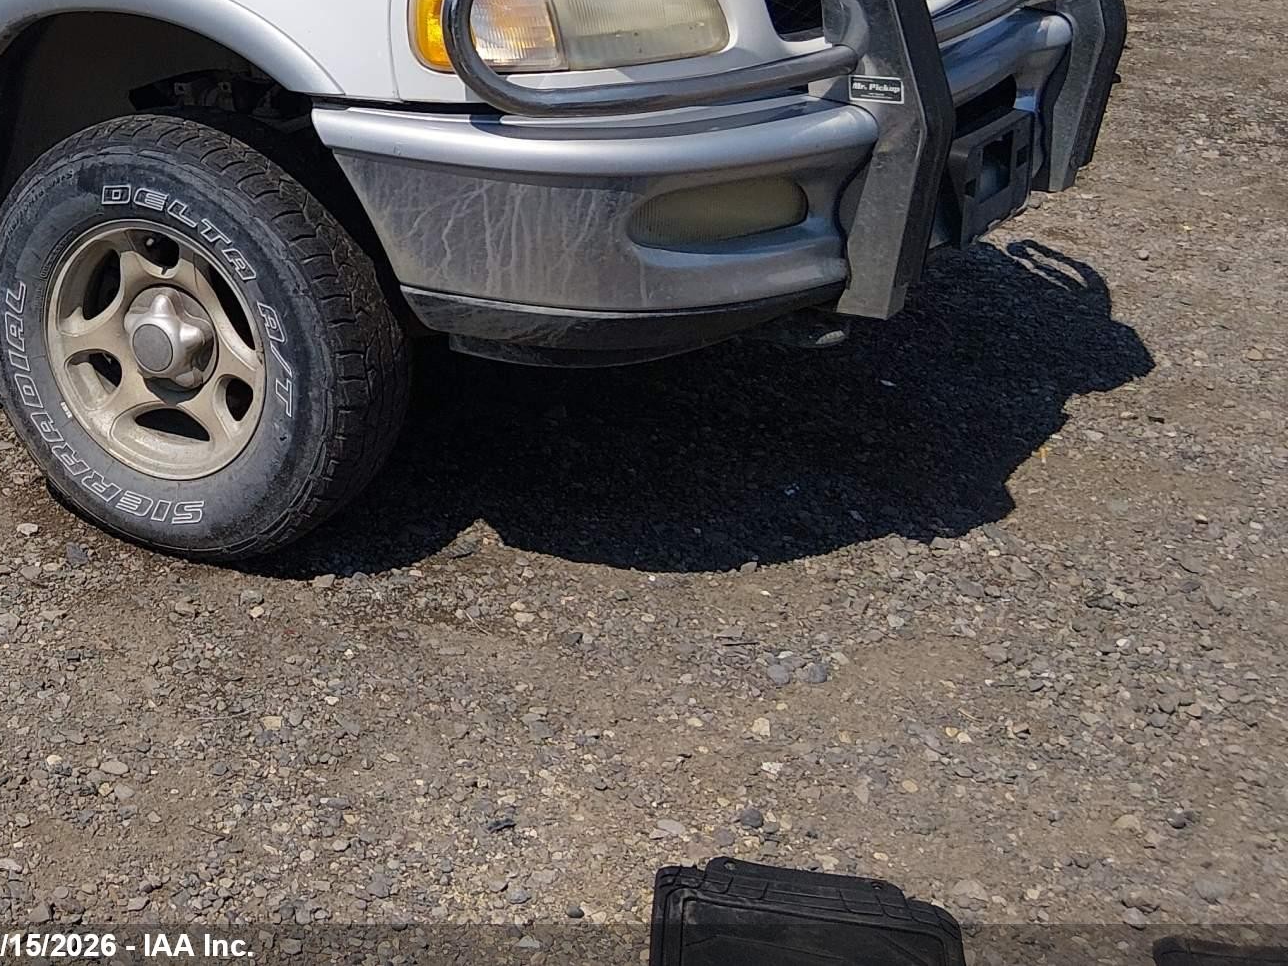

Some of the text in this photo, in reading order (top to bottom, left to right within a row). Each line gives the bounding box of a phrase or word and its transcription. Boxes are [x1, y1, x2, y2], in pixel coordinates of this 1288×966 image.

[869, 83, 901, 94] Pickup
[4, 281, 206, 526] SIERRADIAL
[101, 184, 294, 418] DELTA A/T
